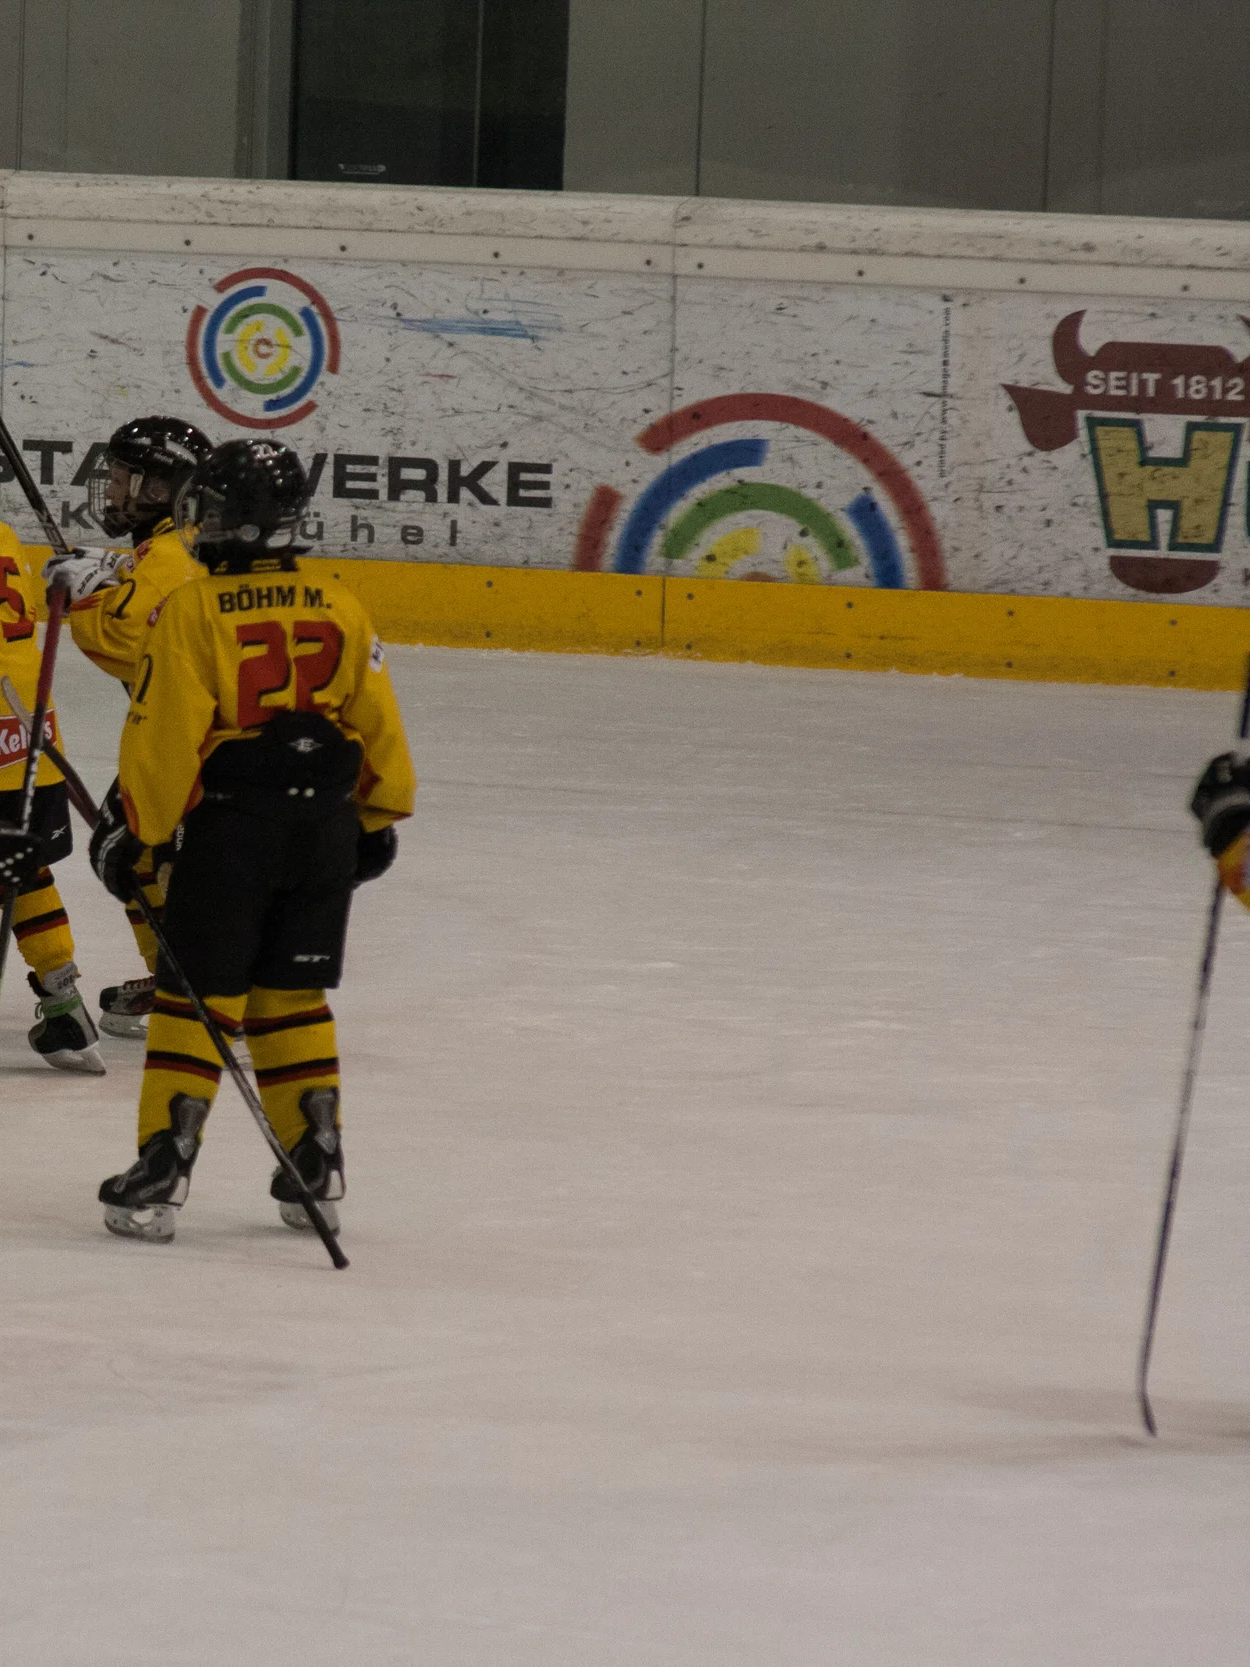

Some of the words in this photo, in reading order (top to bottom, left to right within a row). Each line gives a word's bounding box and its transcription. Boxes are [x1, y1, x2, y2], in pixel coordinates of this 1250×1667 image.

[1083, 369, 1162, 397] SEIT
[1171, 374, 1246, 401] 1812
[217, 584, 297, 614] BÖHM
[303, 587, 333, 609] M.
[236, 619, 347, 729] 22
